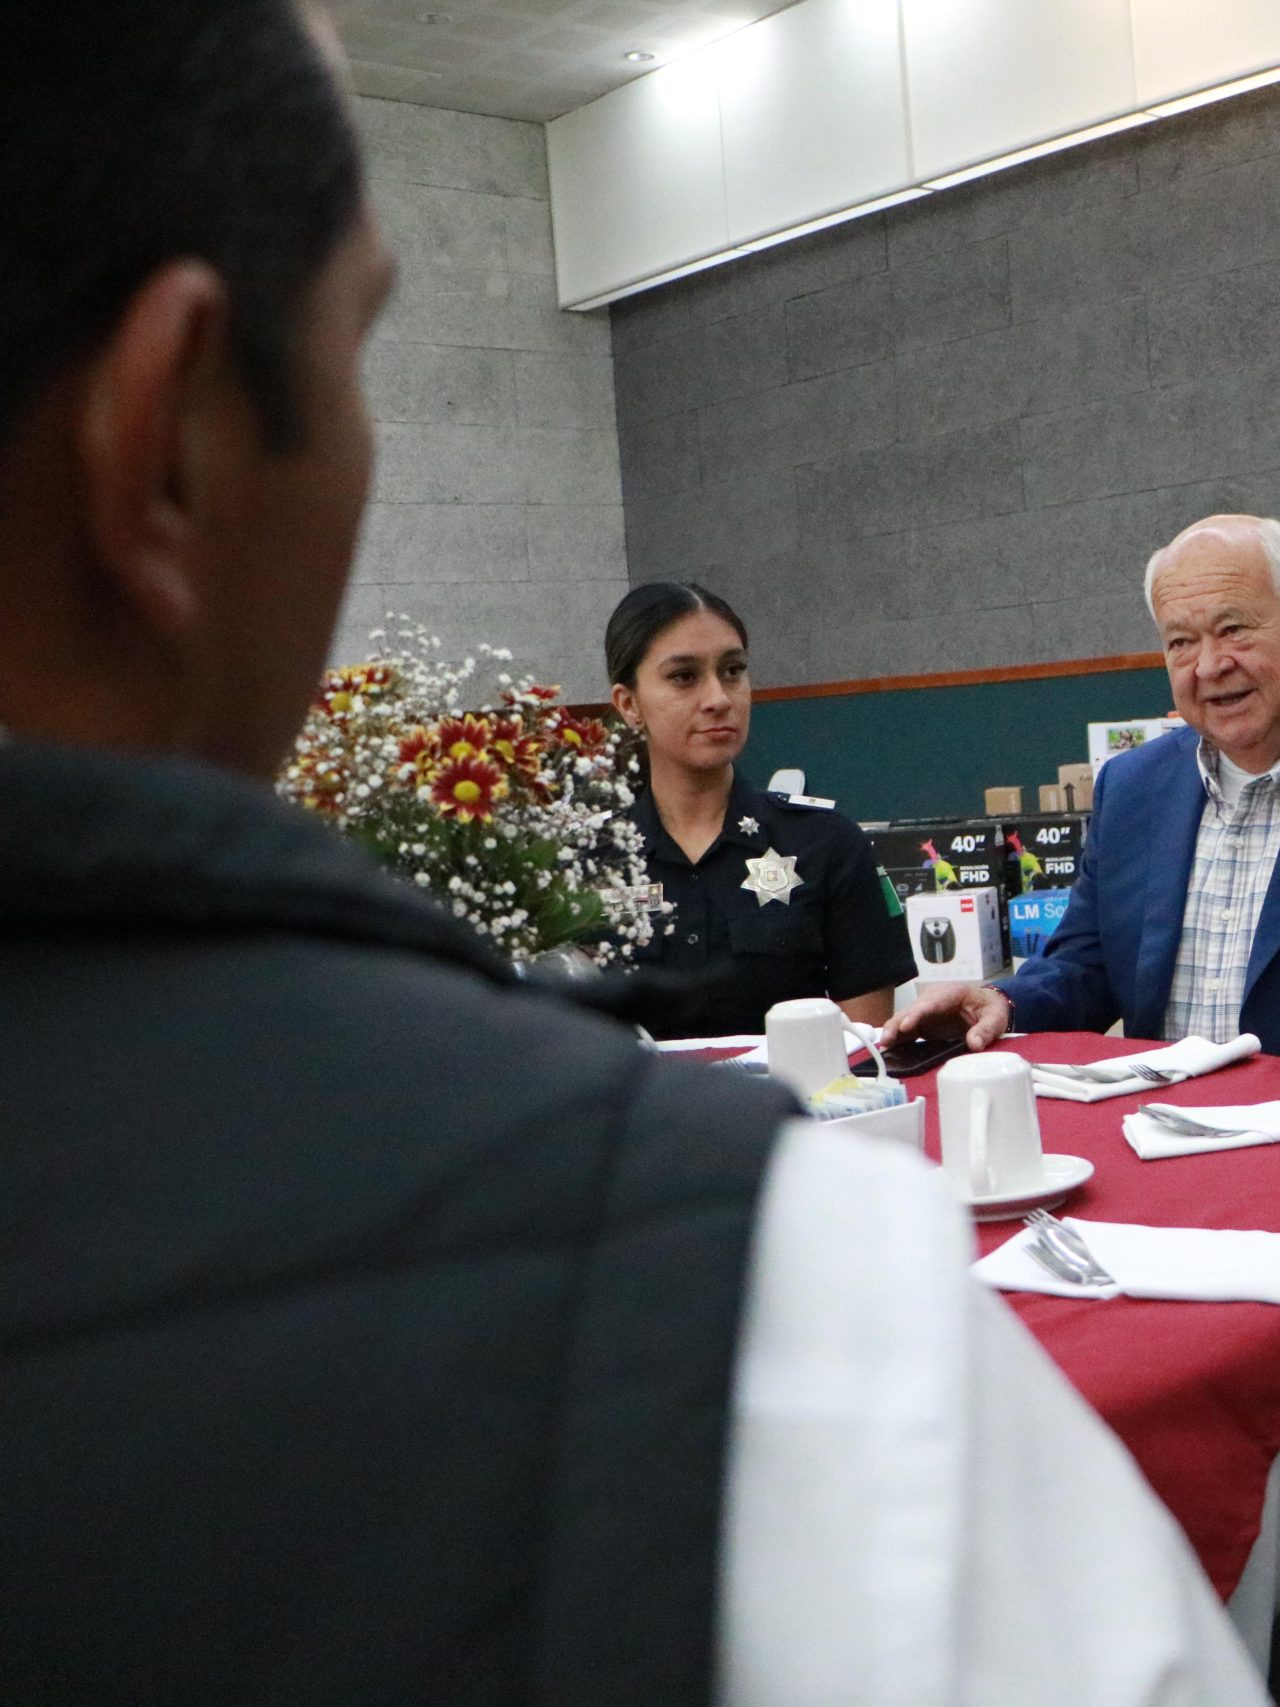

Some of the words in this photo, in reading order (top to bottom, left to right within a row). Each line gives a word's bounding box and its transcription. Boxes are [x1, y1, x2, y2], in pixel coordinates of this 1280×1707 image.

[1045, 861, 1075, 875] FHD
[959, 870, 990, 883] FHD
[1013, 903, 1040, 919] LM
